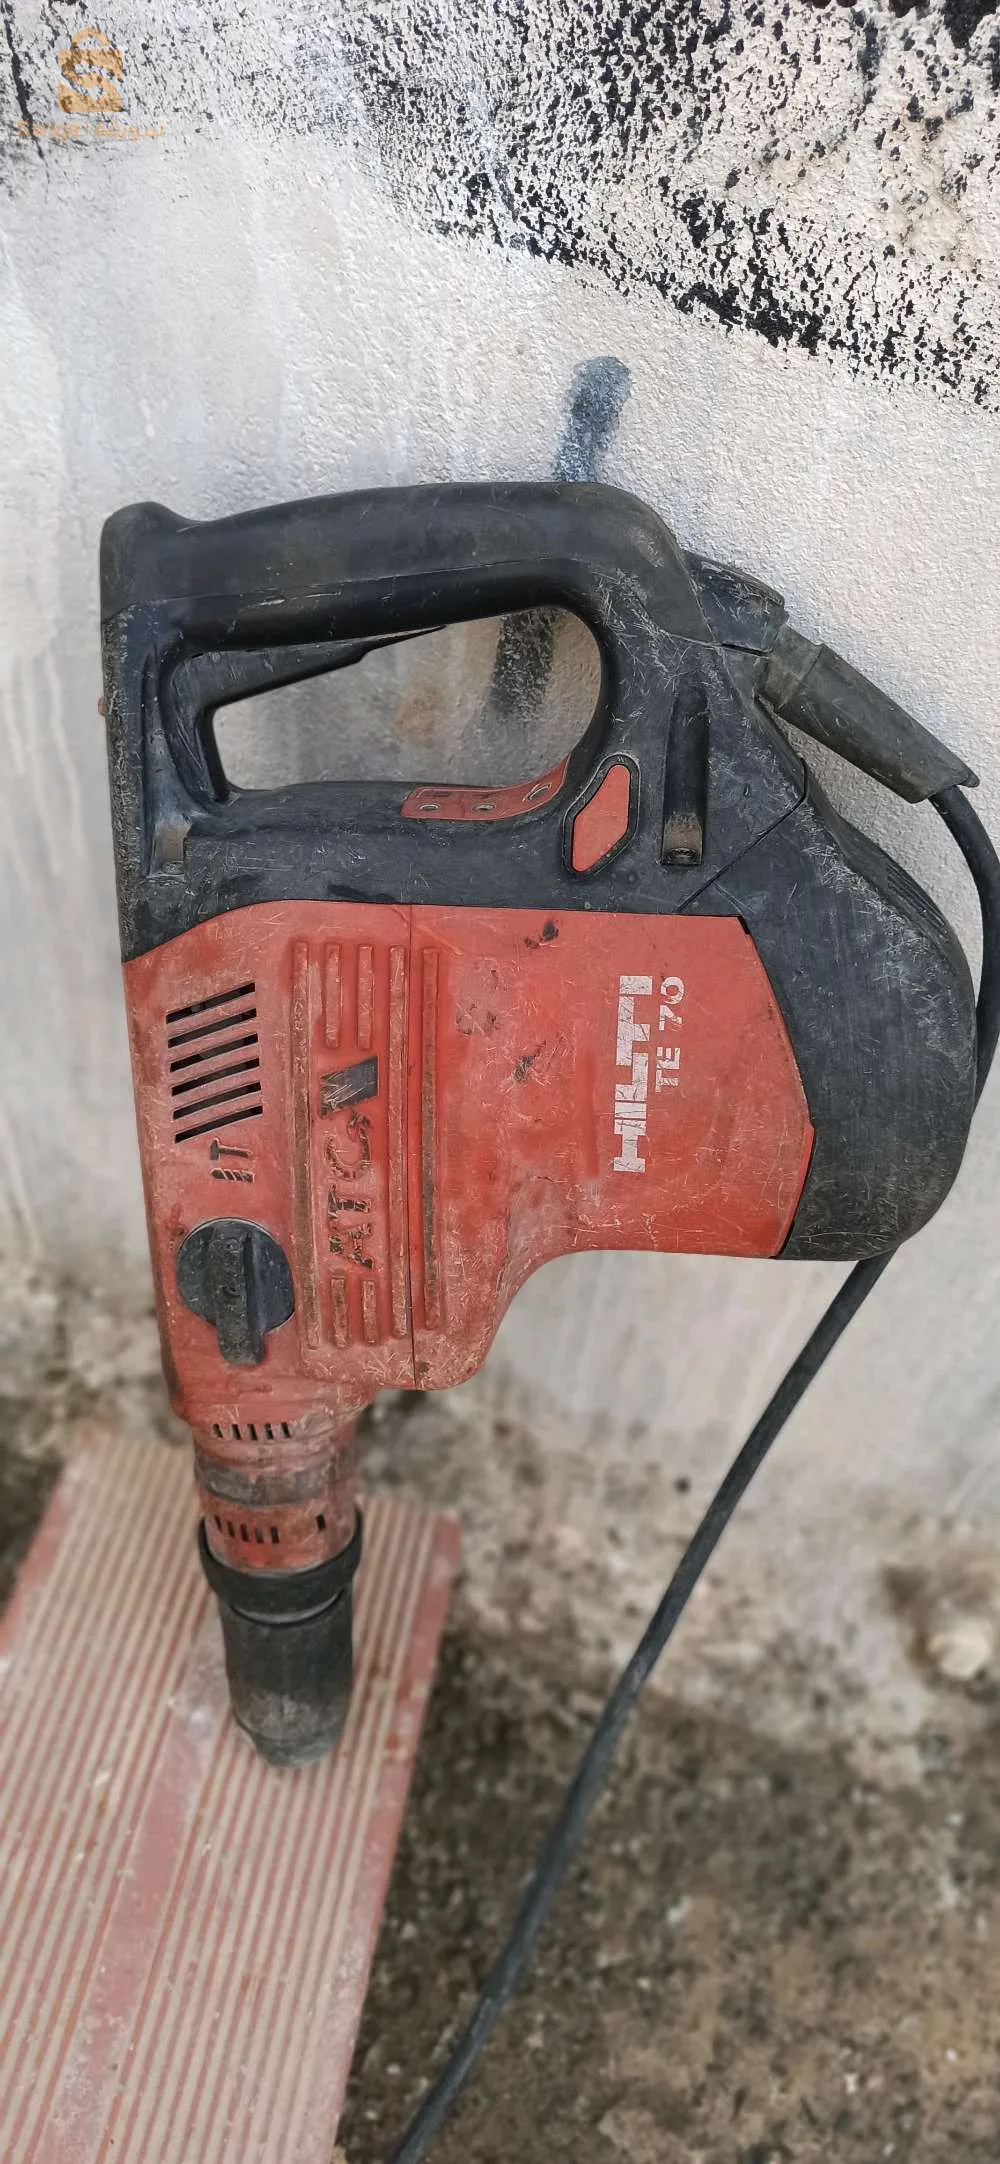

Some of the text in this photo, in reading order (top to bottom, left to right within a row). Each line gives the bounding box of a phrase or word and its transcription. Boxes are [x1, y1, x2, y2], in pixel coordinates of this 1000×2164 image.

[613, 975, 653, 1172] HILTI
[655, 976, 685, 1093] TE 70
